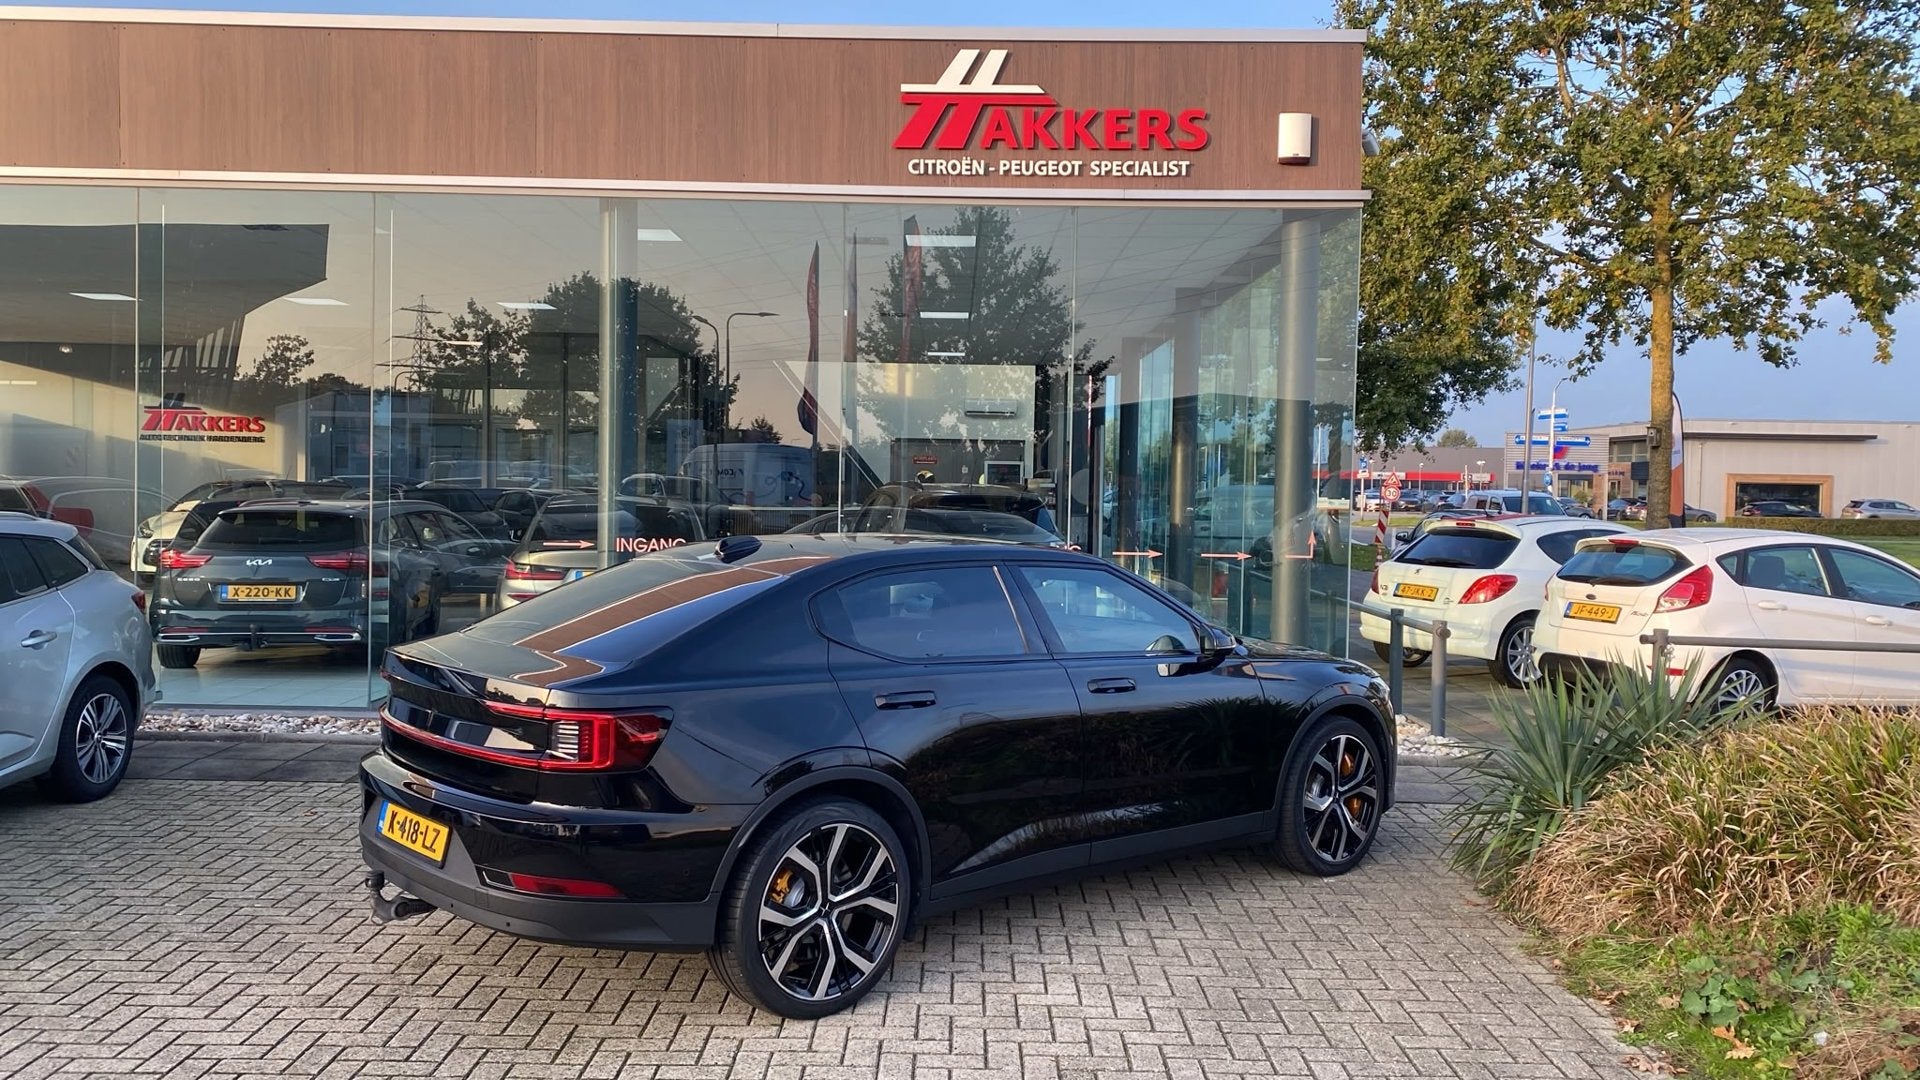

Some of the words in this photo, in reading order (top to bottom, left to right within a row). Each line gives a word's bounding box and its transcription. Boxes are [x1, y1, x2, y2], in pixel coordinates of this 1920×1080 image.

[892, 49, 1209, 150] HAKKERS
[908, 157, 984, 175] CITROËN
[999, 159, 1083, 176] PEUGEOT
[1089, 160, 1190, 176] SPECIALIST
[141, 393, 265, 433] HAKKERS
[232, 587, 292, 597] X-220-KK
[1401, 586, 1434, 597] 47-JKK-2
[1574, 605, 1615, 618] JF-449-J
[388, 810, 440, 853] K-418-LZ
